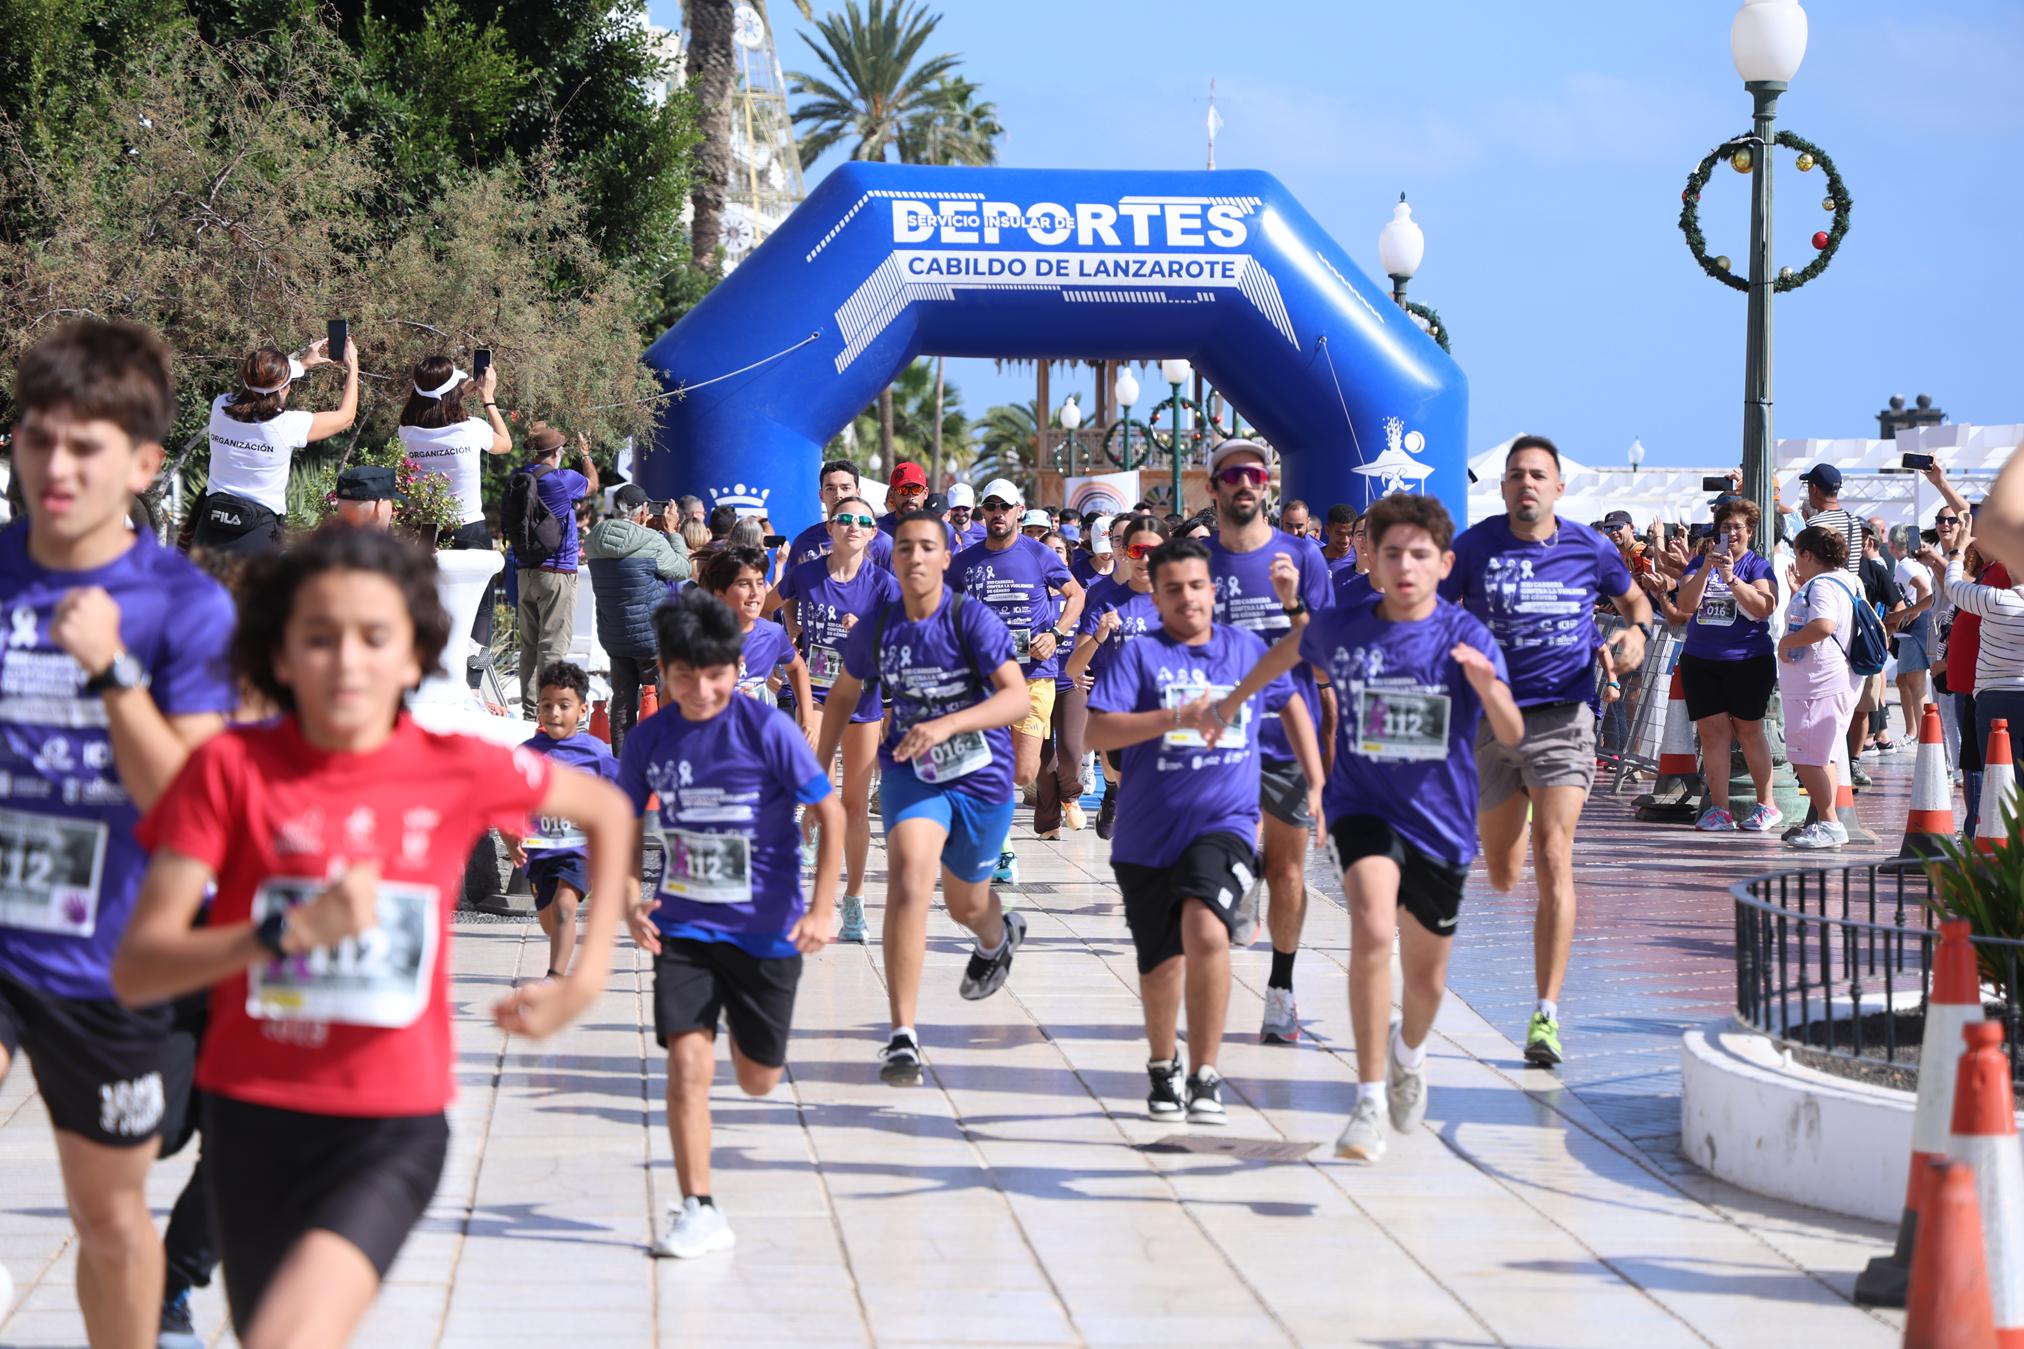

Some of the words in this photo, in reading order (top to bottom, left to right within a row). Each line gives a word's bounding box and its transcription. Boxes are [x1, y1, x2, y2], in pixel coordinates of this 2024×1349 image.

[892, 199, 1248, 248] DEPORTES
[908, 214, 980, 228] SERVICIO
[984, 215, 1051, 229] INSULAR
[1055, 217, 1076, 229] DE
[908, 256, 1027, 277] CABILDO
[1035, 258, 1070, 277] DE
[1078, 259, 1236, 279] LANZAROTE
[210, 433, 275, 454] ORGANIZACIÓN
[408, 445, 472, 459] ORGANIZACIÓN
[210, 509, 242, 526] FILA
[1706, 605, 1726, 617] 016
[824, 661, 841, 675] 11
[1384, 713, 1424, 736] 112
[930, 738, 967, 764] 016
[540, 816, 571, 833] 016
[0, 850, 54, 884] 12
[684, 853, 724, 881] 112
